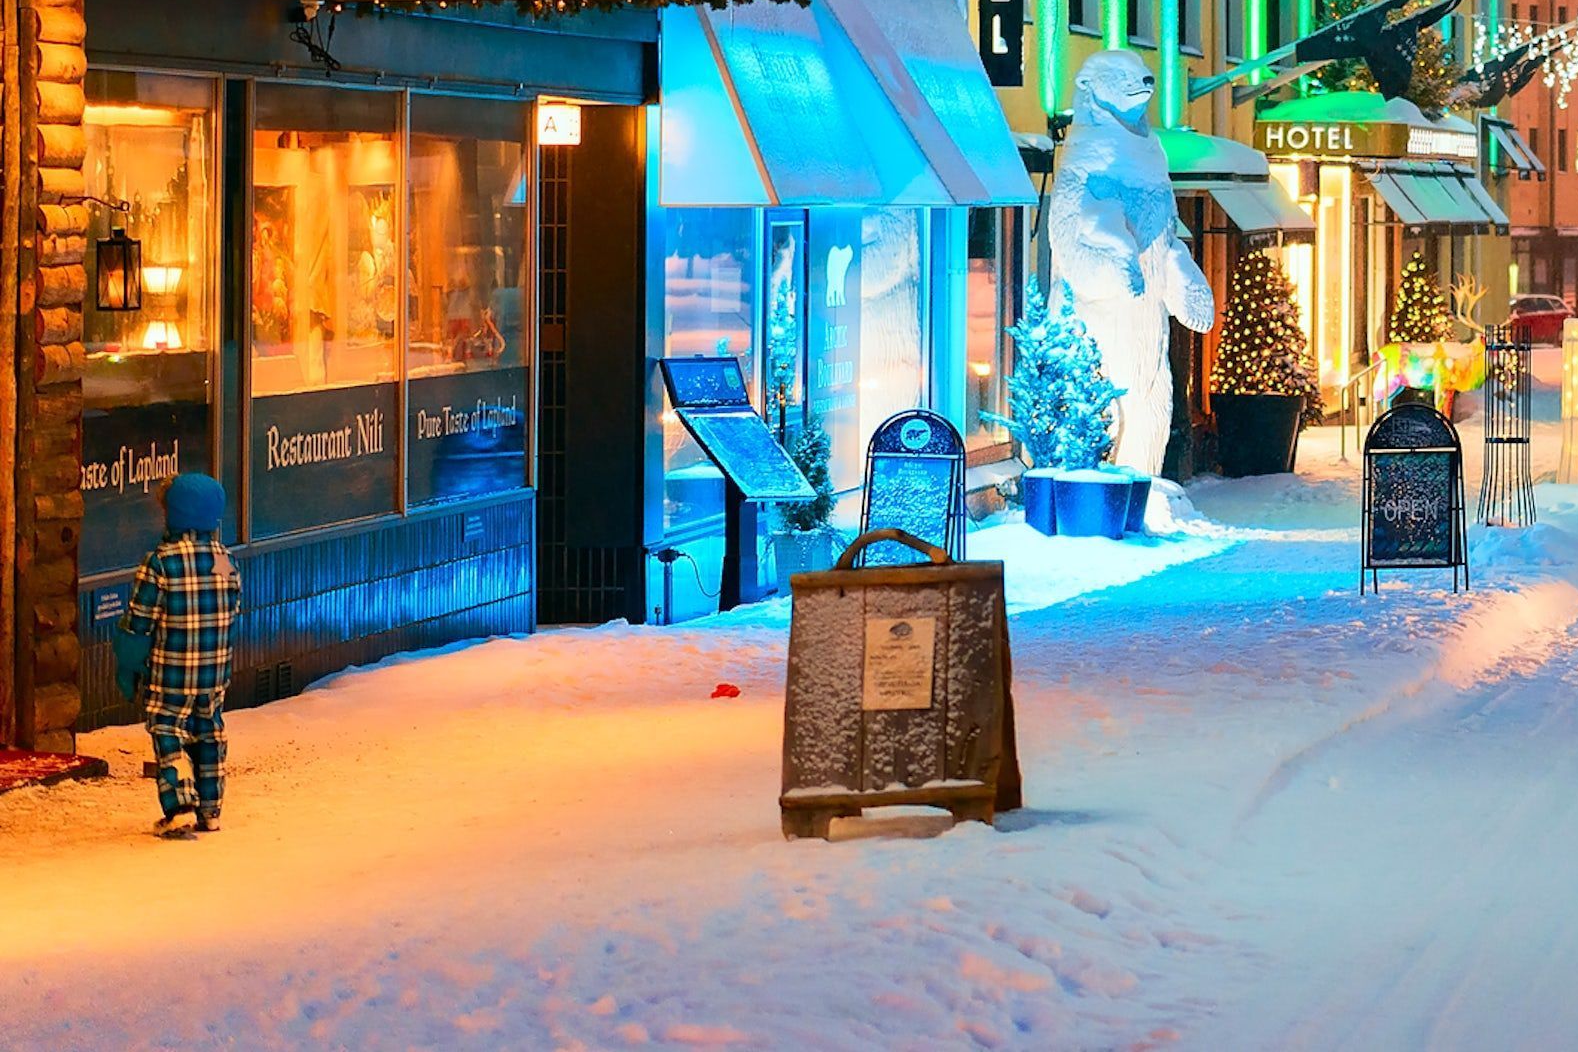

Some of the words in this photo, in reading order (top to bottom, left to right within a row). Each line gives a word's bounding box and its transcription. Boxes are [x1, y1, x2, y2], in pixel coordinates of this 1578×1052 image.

[544, 116, 557, 132] A
[1266, 126, 1353, 149] HOTEL
[417, 409, 442, 439] Pure
[442, 405, 469, 435] Taste
[471, 398, 482, 435] of
[482, 395, 516, 438] Lapland
[267, 425, 352, 471] Restaurant
[356, 407, 384, 456] Nili
[80, 461, 108, 490] aste
[111, 445, 127, 494] of
[128, 439, 179, 494] Lapland
[1384, 499, 1438, 522] OPEN
